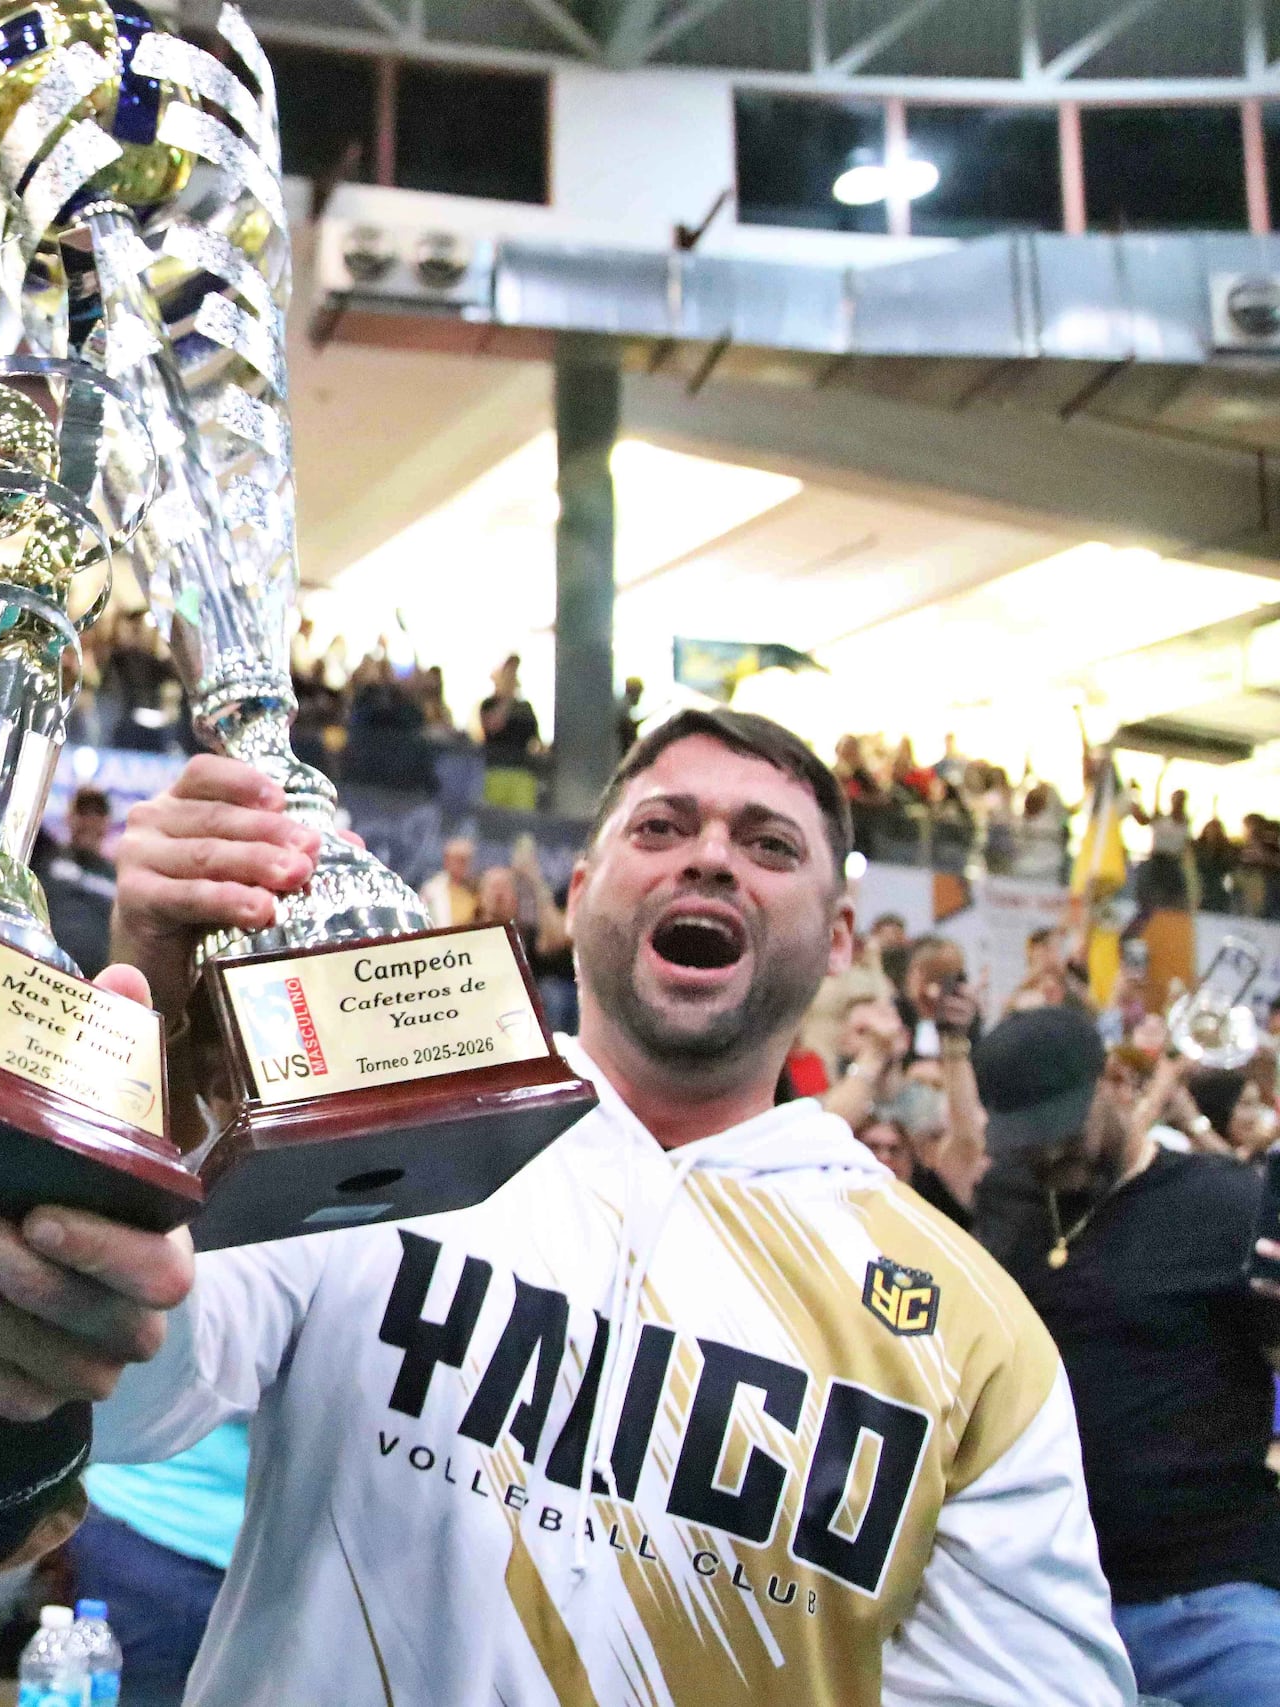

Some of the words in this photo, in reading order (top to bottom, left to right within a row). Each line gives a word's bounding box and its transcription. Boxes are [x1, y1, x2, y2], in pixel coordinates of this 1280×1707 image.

[354, 950, 473, 983] Campeón
[24, 965, 113, 1012] Jugador
[339, 986, 451, 1013] Cafeteros
[460, 978, 486, 993] de
[1, 974, 50, 1006] Mas
[60, 1000, 136, 1045] Valioso
[8, 1000, 67, 1036] Serie
[286, 978, 327, 1075] MASCULINO
[390, 1008, 459, 1029] Yauco
[261, 1053, 310, 1083] LVS
[356, 1056, 409, 1074] Torneo
[413, 1037, 495, 1065] 2025-2026
[378, 1431, 657, 1560] VOLLEBALL
[692, 1551, 816, 1615] CLUB
